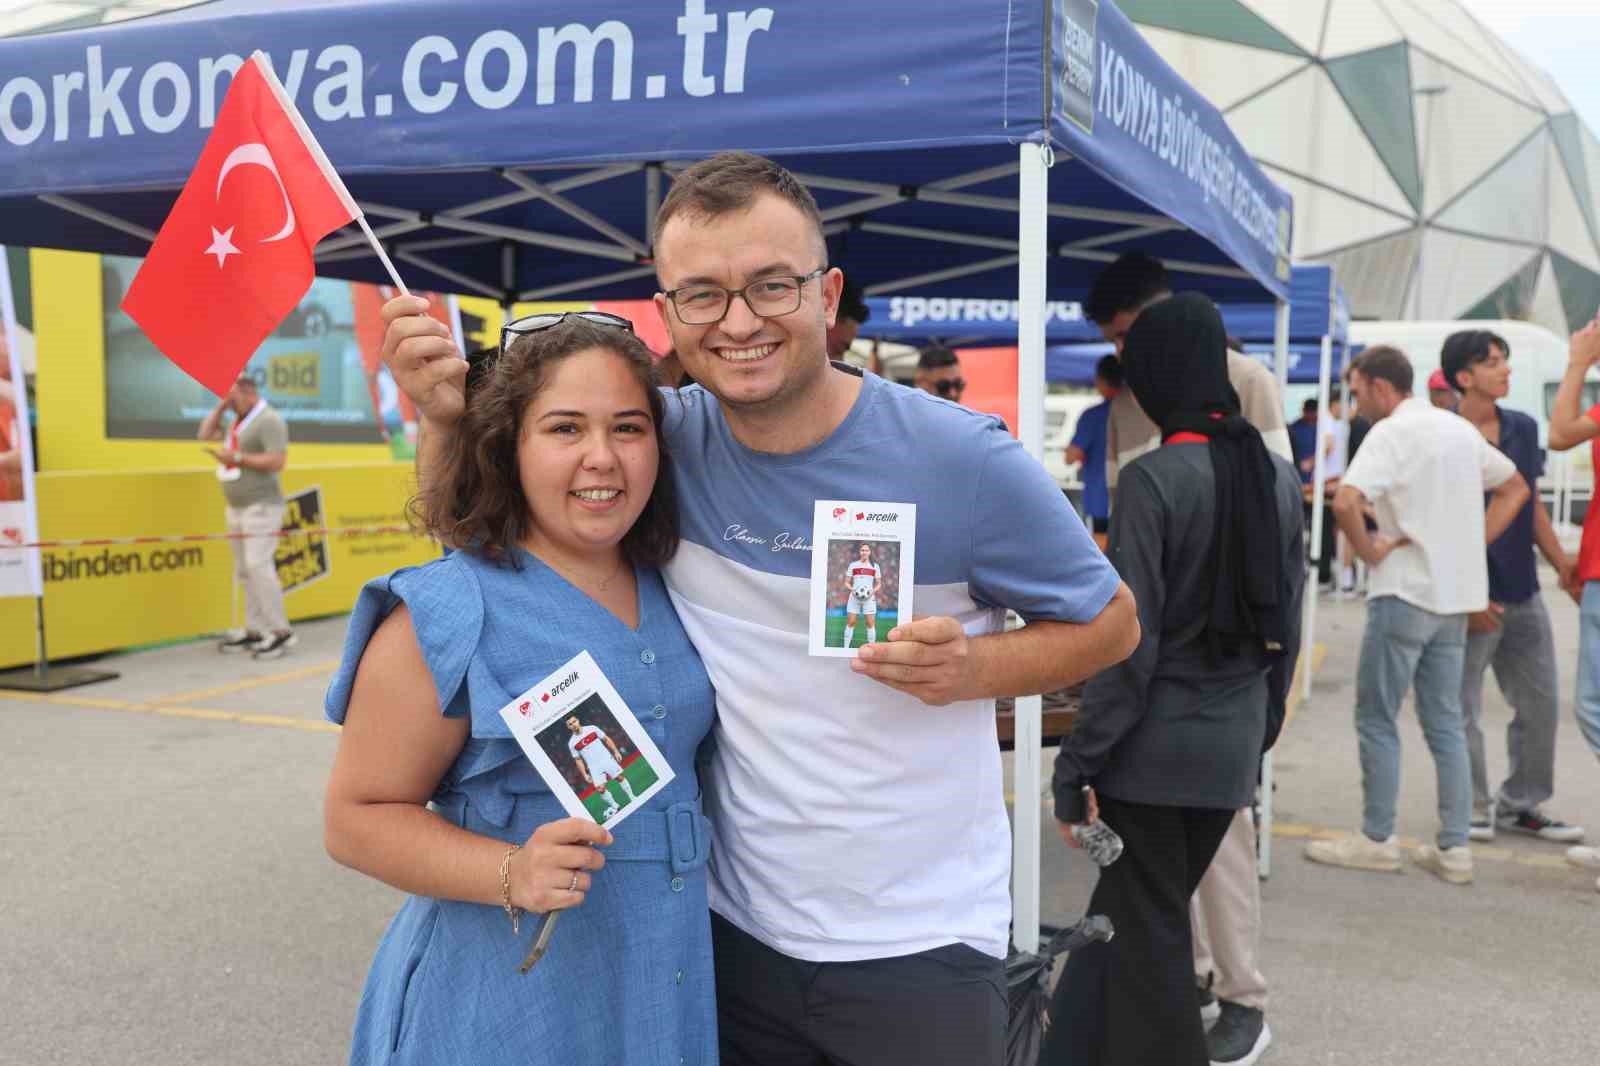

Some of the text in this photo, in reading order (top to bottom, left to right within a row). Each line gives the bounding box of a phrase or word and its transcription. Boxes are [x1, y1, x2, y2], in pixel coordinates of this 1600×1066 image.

[1098, 40, 1159, 153] KONYA
[1159, 94, 1236, 213] BÜYÜKŞEHİR
[723, 524, 767, 545] Classic
